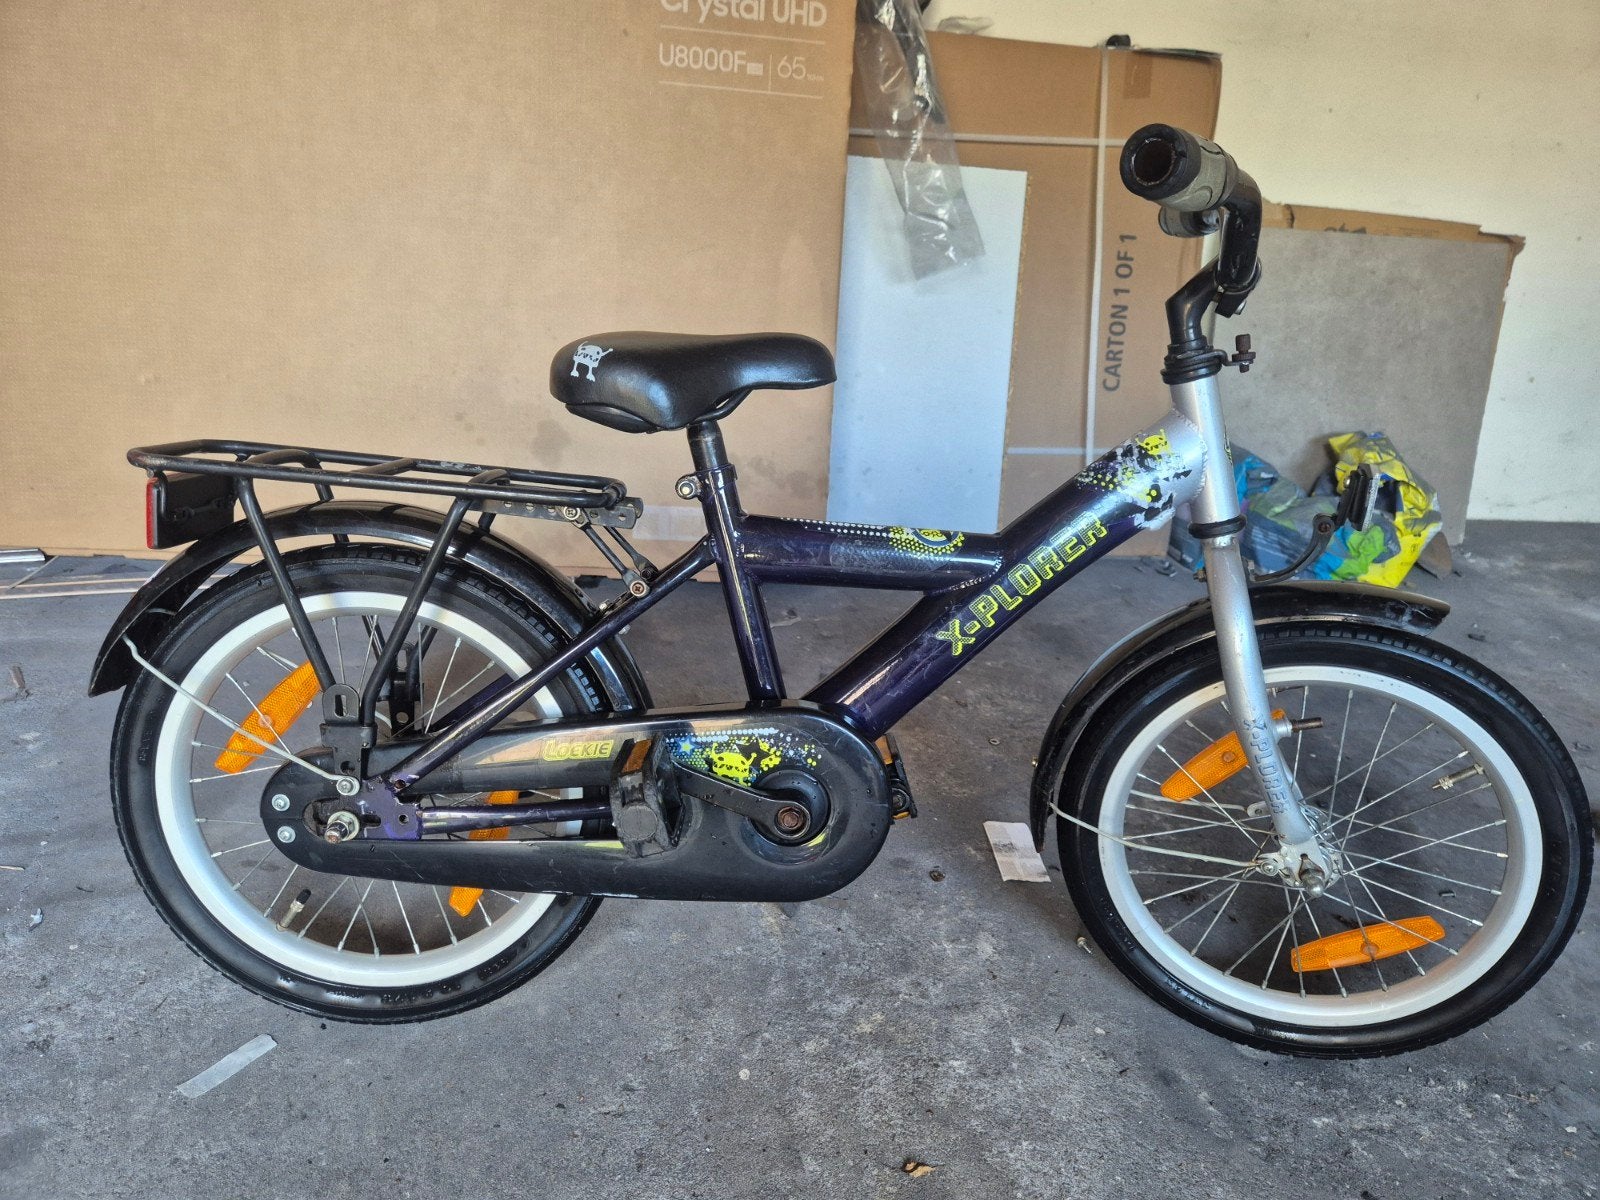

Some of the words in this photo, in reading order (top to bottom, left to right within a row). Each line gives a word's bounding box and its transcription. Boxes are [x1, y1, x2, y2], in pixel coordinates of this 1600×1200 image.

[772, 0, 827, 27] UHD
[659, 43, 747, 73] U8000F
[777, 55, 806, 80] 65
[1119, 234, 1137, 243] 1
[1115, 251, 1134, 279] OF
[1114, 288, 1131, 296] 1
[1102, 304, 1129, 392] CARTON
[935, 510, 1108, 656] X-PLORER
